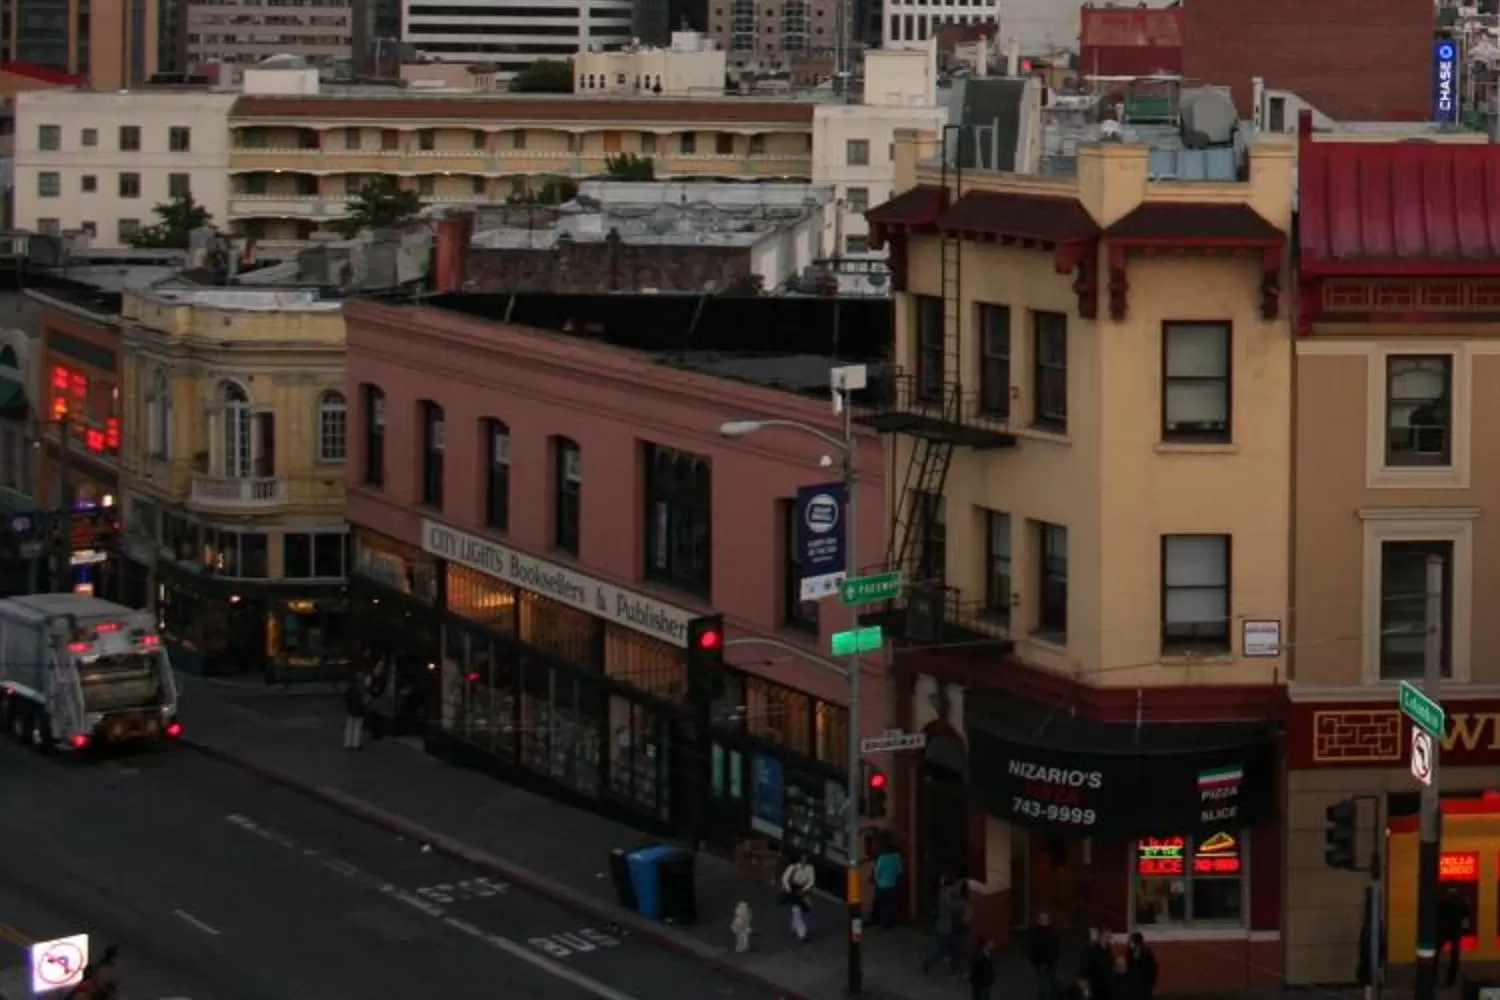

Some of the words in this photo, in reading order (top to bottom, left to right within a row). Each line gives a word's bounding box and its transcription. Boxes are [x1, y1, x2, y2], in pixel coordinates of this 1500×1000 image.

[1440, 61, 1452, 111] CHASE
[430, 526, 457, 557] CITY
[460, 535, 504, 573] LIGHTS
[510, 556, 586, 603] Booksellers
[616, 593, 688, 639] Publisher
[1008, 759, 1104, 789] NIZARIO'S
[1201, 786, 1238, 801] PIZZA
[1012, 796, 1097, 825] 743-9999
[1200, 806, 1238, 823] SLICE
